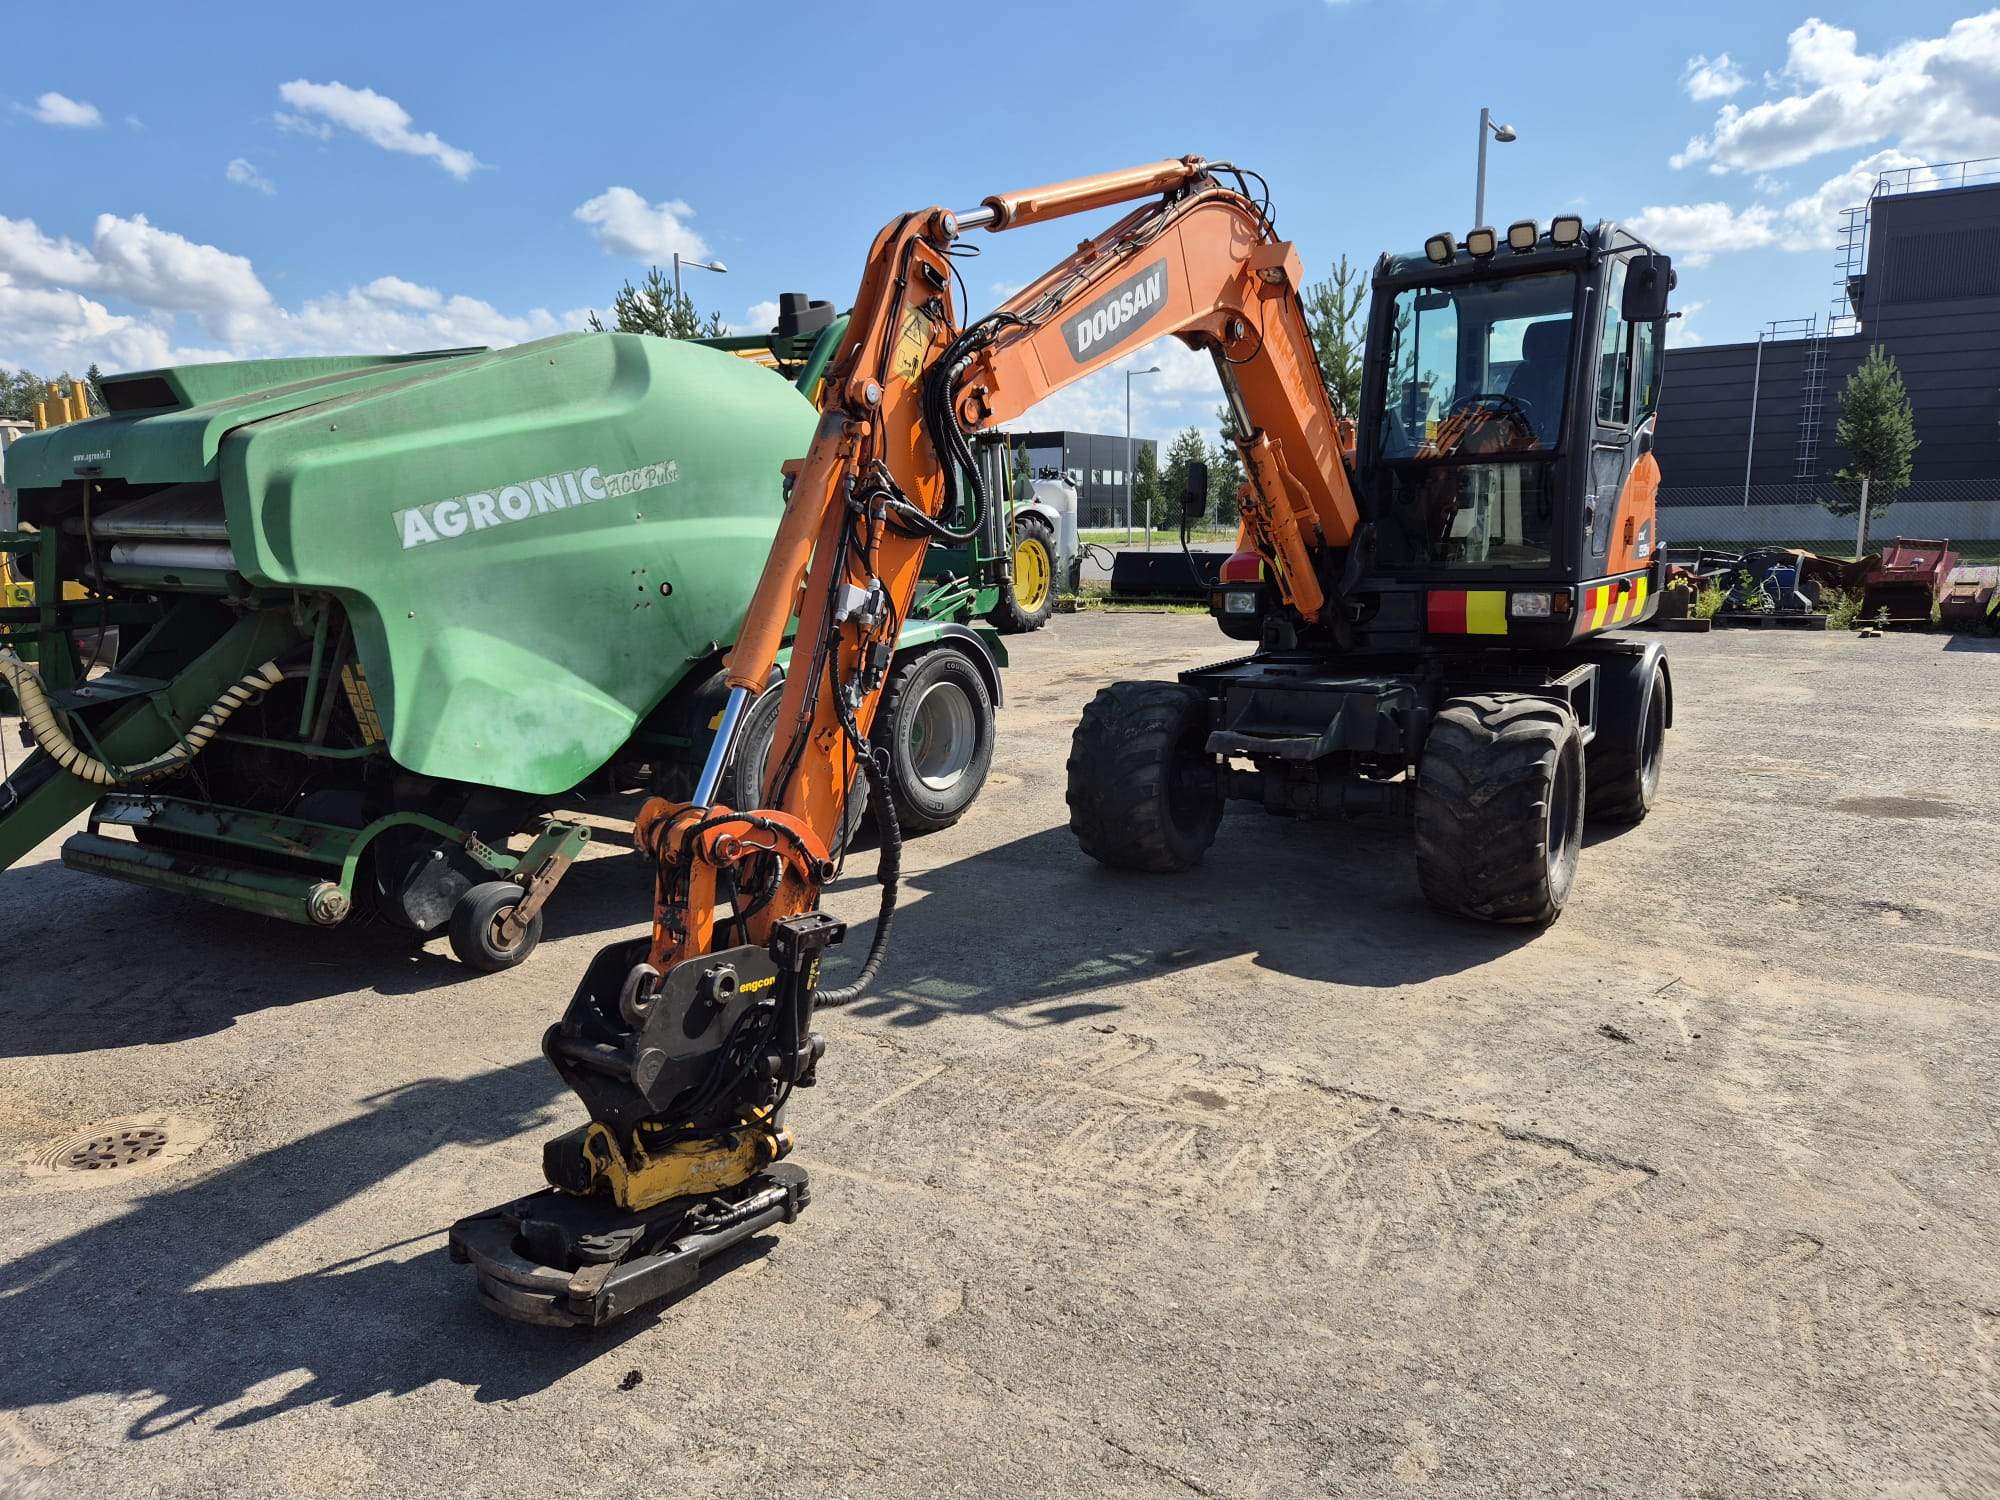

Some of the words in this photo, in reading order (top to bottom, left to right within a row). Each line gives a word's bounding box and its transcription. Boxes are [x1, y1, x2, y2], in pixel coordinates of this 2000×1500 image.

[1078, 271, 1160, 353] DOOSAN
[402, 467, 608, 550] AGRONIC
[739, 976, 776, 992] engcon
